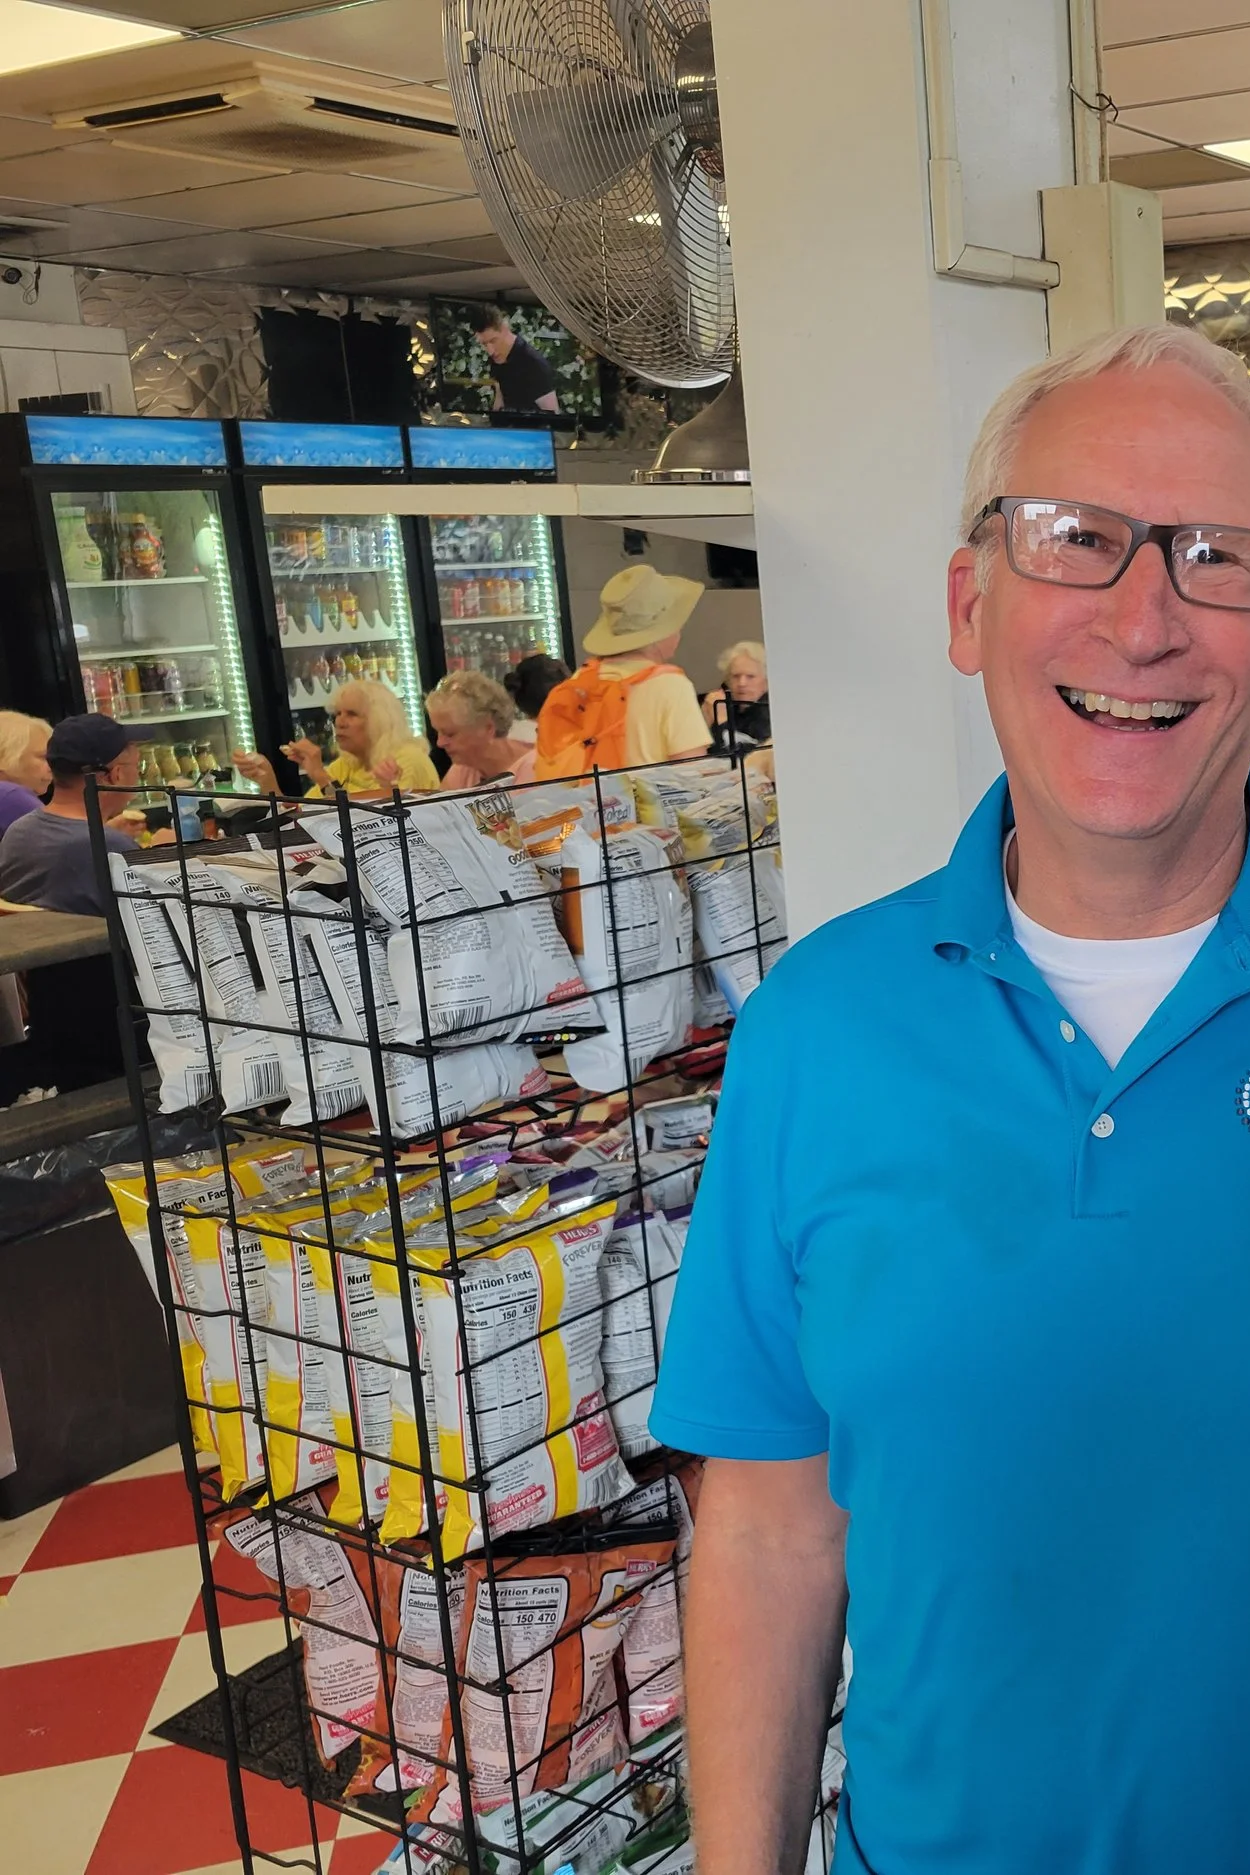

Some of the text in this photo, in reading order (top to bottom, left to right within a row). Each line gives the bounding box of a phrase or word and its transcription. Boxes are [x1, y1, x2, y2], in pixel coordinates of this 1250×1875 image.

[213, 891, 231, 901] 140
[505, 1268, 534, 1287] Facts
[350, 1307, 378, 1319] Calories
[501, 1303, 538, 1321] 150 430
[481, 1586, 560, 1599] Ntrition Facts
[516, 1612, 557, 1624] 150 470
